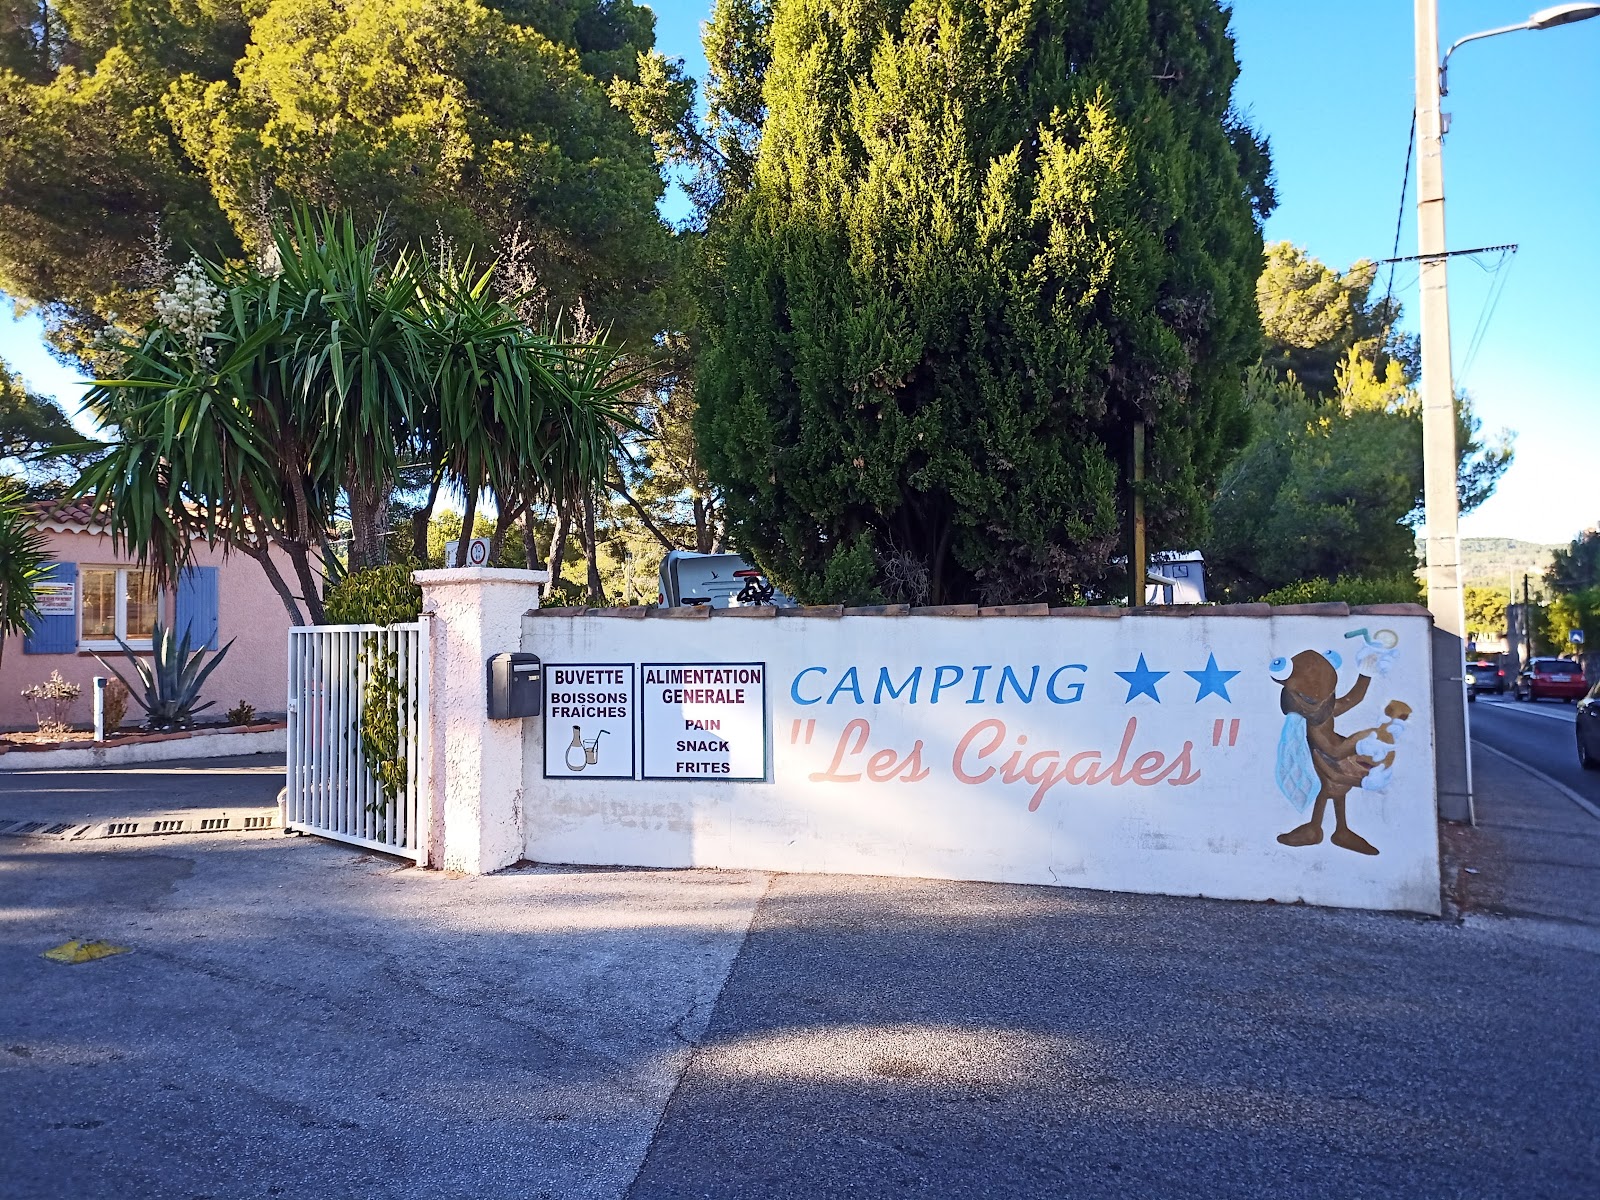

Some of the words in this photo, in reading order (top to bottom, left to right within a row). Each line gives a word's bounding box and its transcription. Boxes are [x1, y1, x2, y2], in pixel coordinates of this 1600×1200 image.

[555, 669, 624, 685] BUVETTE
[645, 669, 762, 684] ALIMENTATION
[790, 664, 1088, 705] CAMPING
[551, 693, 628, 704] BOISSONS
[662, 689, 745, 704] GENERALE
[552, 704, 627, 718] FRAÎCHES
[685, 719, 721, 731] PAIN
[676, 741, 730, 752] SNACK
[676, 762, 731, 774] FRITES
